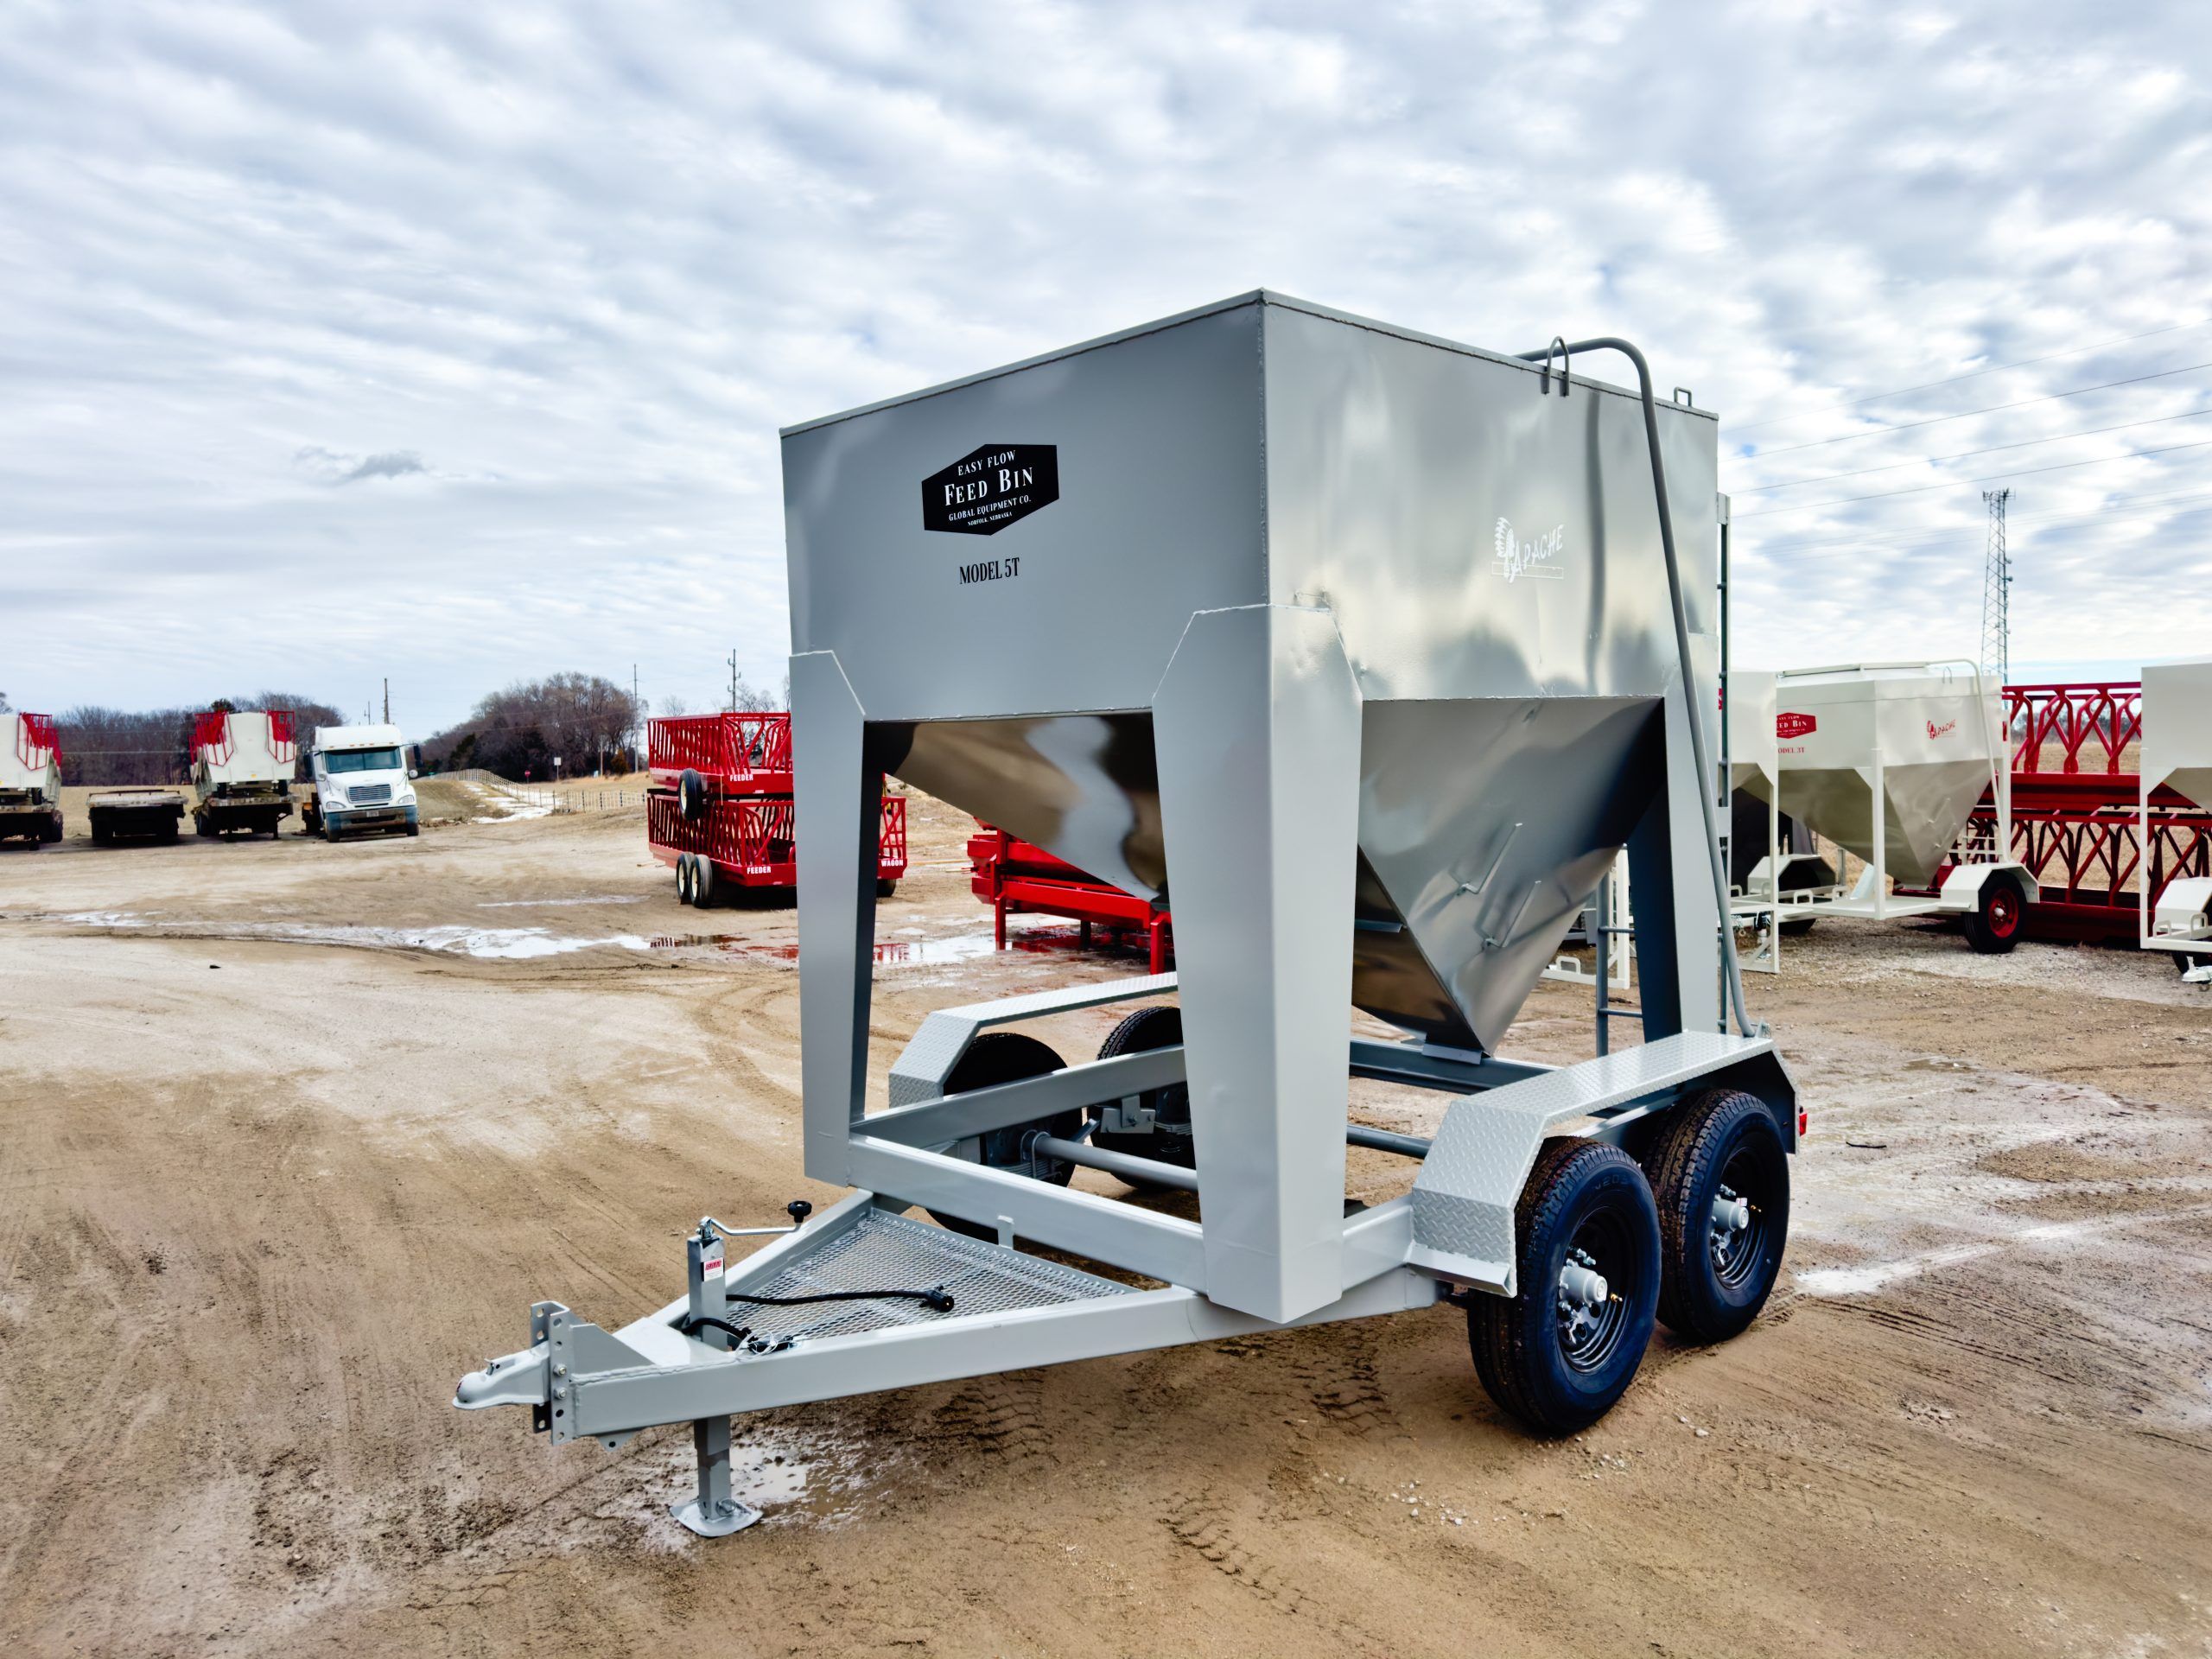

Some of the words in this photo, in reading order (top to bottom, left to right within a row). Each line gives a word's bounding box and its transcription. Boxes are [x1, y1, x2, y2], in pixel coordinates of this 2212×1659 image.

[957, 460, 982, 476] EASY
[987, 449, 1016, 468] FLOW
[944, 480, 988, 506] FEED
[999, 467, 1033, 493] BIN
[949, 507, 976, 522] GLOBAL
[976, 497, 1018, 516] EQUIPMENT
[1019, 494, 1032, 505] CO.
[989, 511, 1013, 522] NEBRASKA
[1509, 524, 1564, 583] APACHE
[959, 560, 1003, 585] MODEL
[1004, 556, 1020, 578] 5T
[729, 773, 753, 782] FEEDER
[747, 866, 772, 874] FEEDER
[880, 859, 904, 868] WAGON
